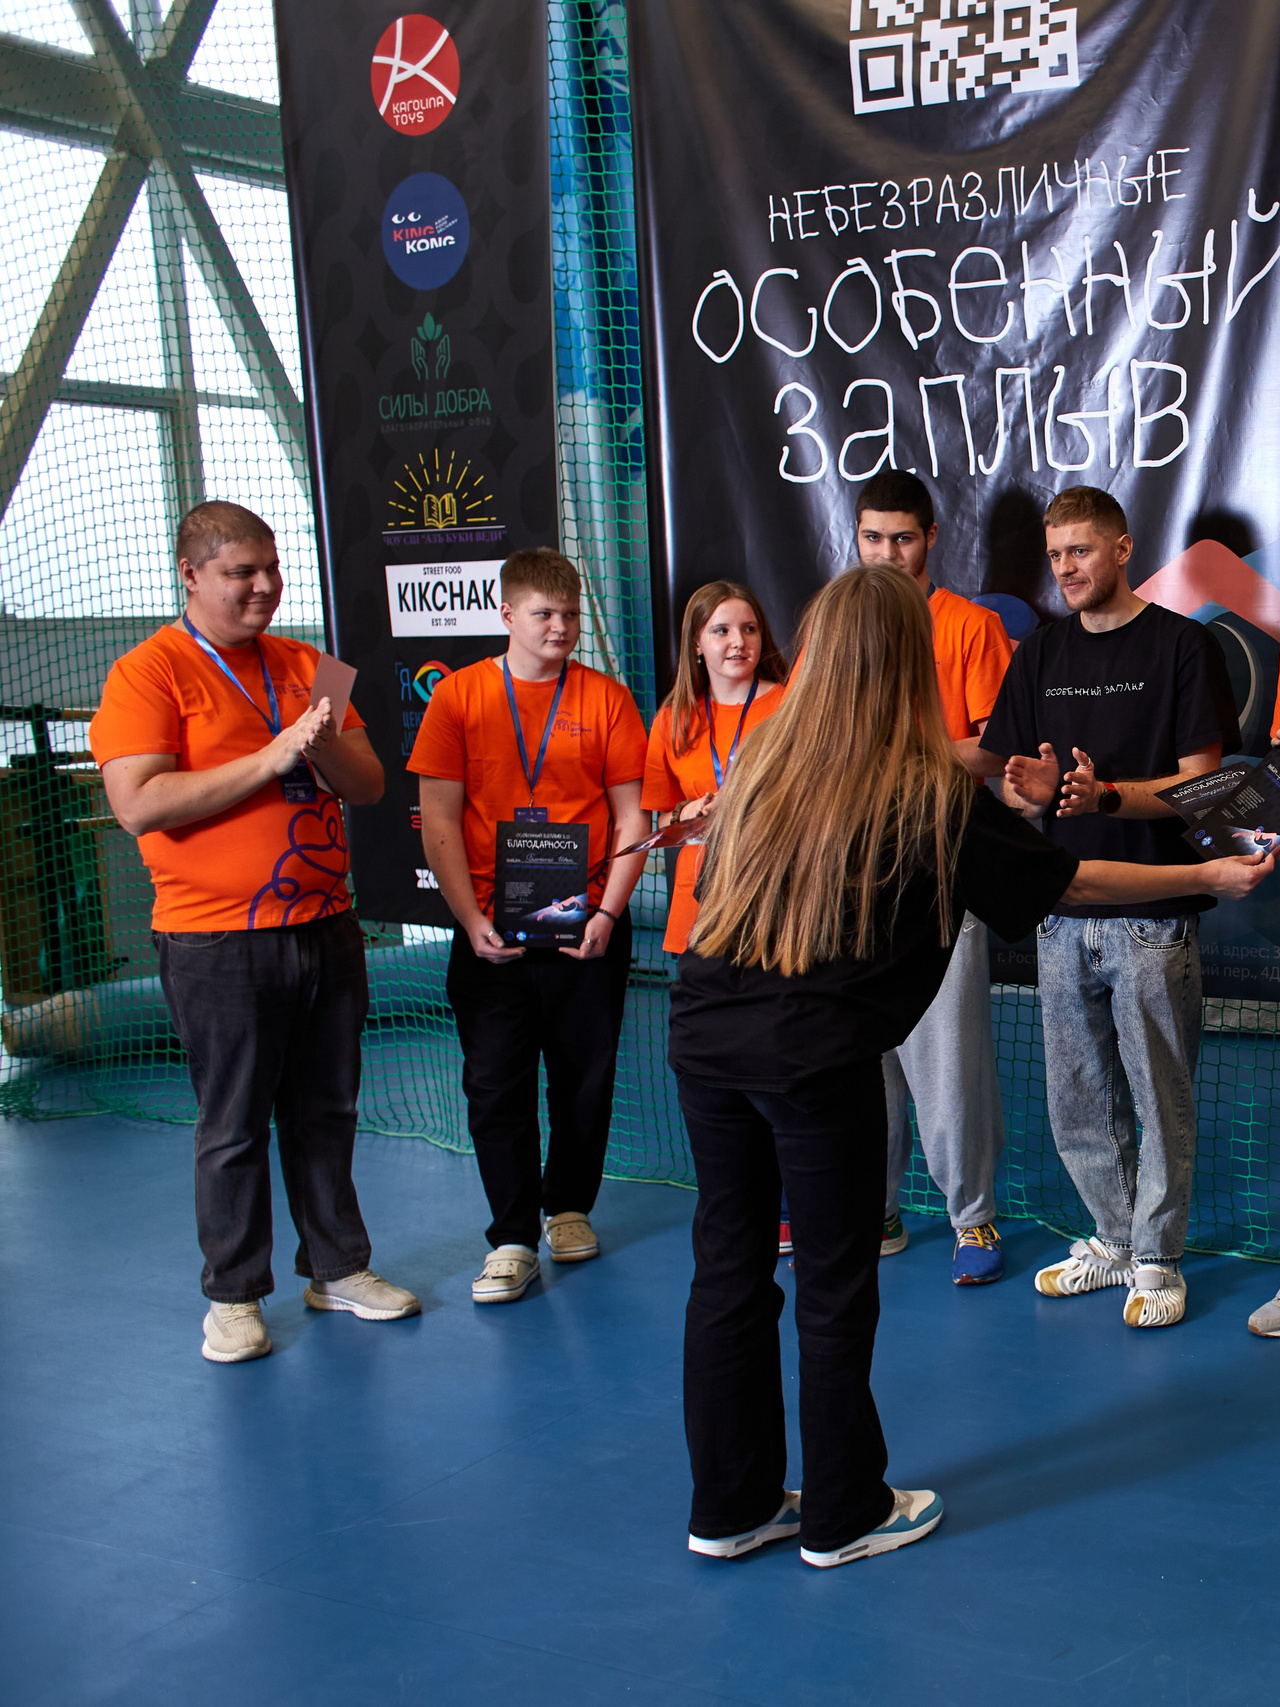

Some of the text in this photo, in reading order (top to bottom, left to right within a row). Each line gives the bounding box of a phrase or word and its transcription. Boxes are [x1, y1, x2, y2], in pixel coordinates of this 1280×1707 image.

[393, 111, 424, 126] TOYS
[768, 148, 1191, 243] НЕБЕЗРАЗЛИЧНЫЕ
[393, 225, 435, 242] KING
[405, 235, 456, 255] KONG
[378, 387, 492, 420] СИЛЫ ДОБРА
[773, 359, 1190, 483] ЗАПЛЫВ
[423, 565, 462, 576] STREET FOOD
[397, 579, 498, 613] KIKCHAK
[431, 617, 457, 627] EST. 2012
[1045, 682, 1145, 697] ОСОБЕННЫЙ ЗАПЛЫВ
[402, 711, 425, 730] ЦЕН
[507, 838, 578, 850] БЛАГОДАРНОСТЬ
[1223, 945, 1270, 959] адрес:
[1201, 963, 1219, 976] ий
